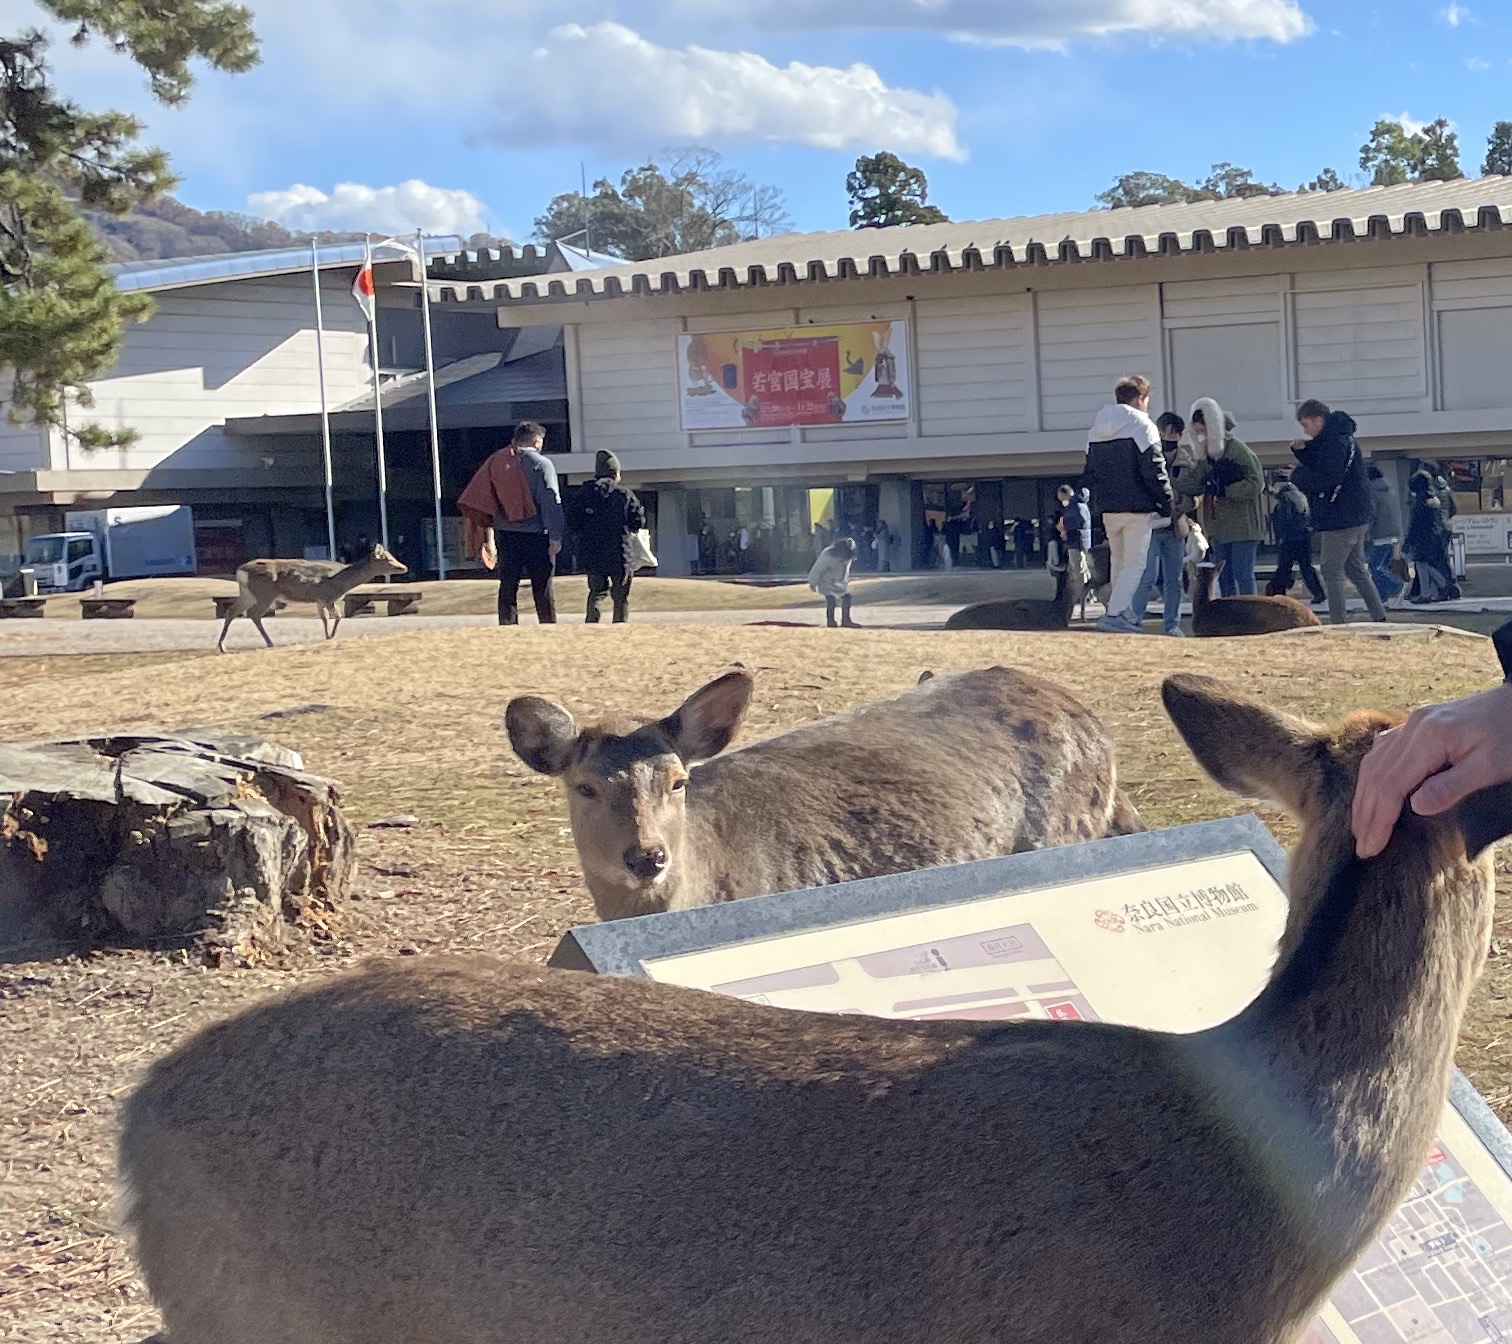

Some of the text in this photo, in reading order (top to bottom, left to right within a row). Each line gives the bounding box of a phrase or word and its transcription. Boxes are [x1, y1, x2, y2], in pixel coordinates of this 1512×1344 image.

[752, 367, 833, 393] 若宮国宝展
[1120, 882, 1250, 923] 奈良国立博物館
[1132, 901, 1260, 935] Nara National Museum
